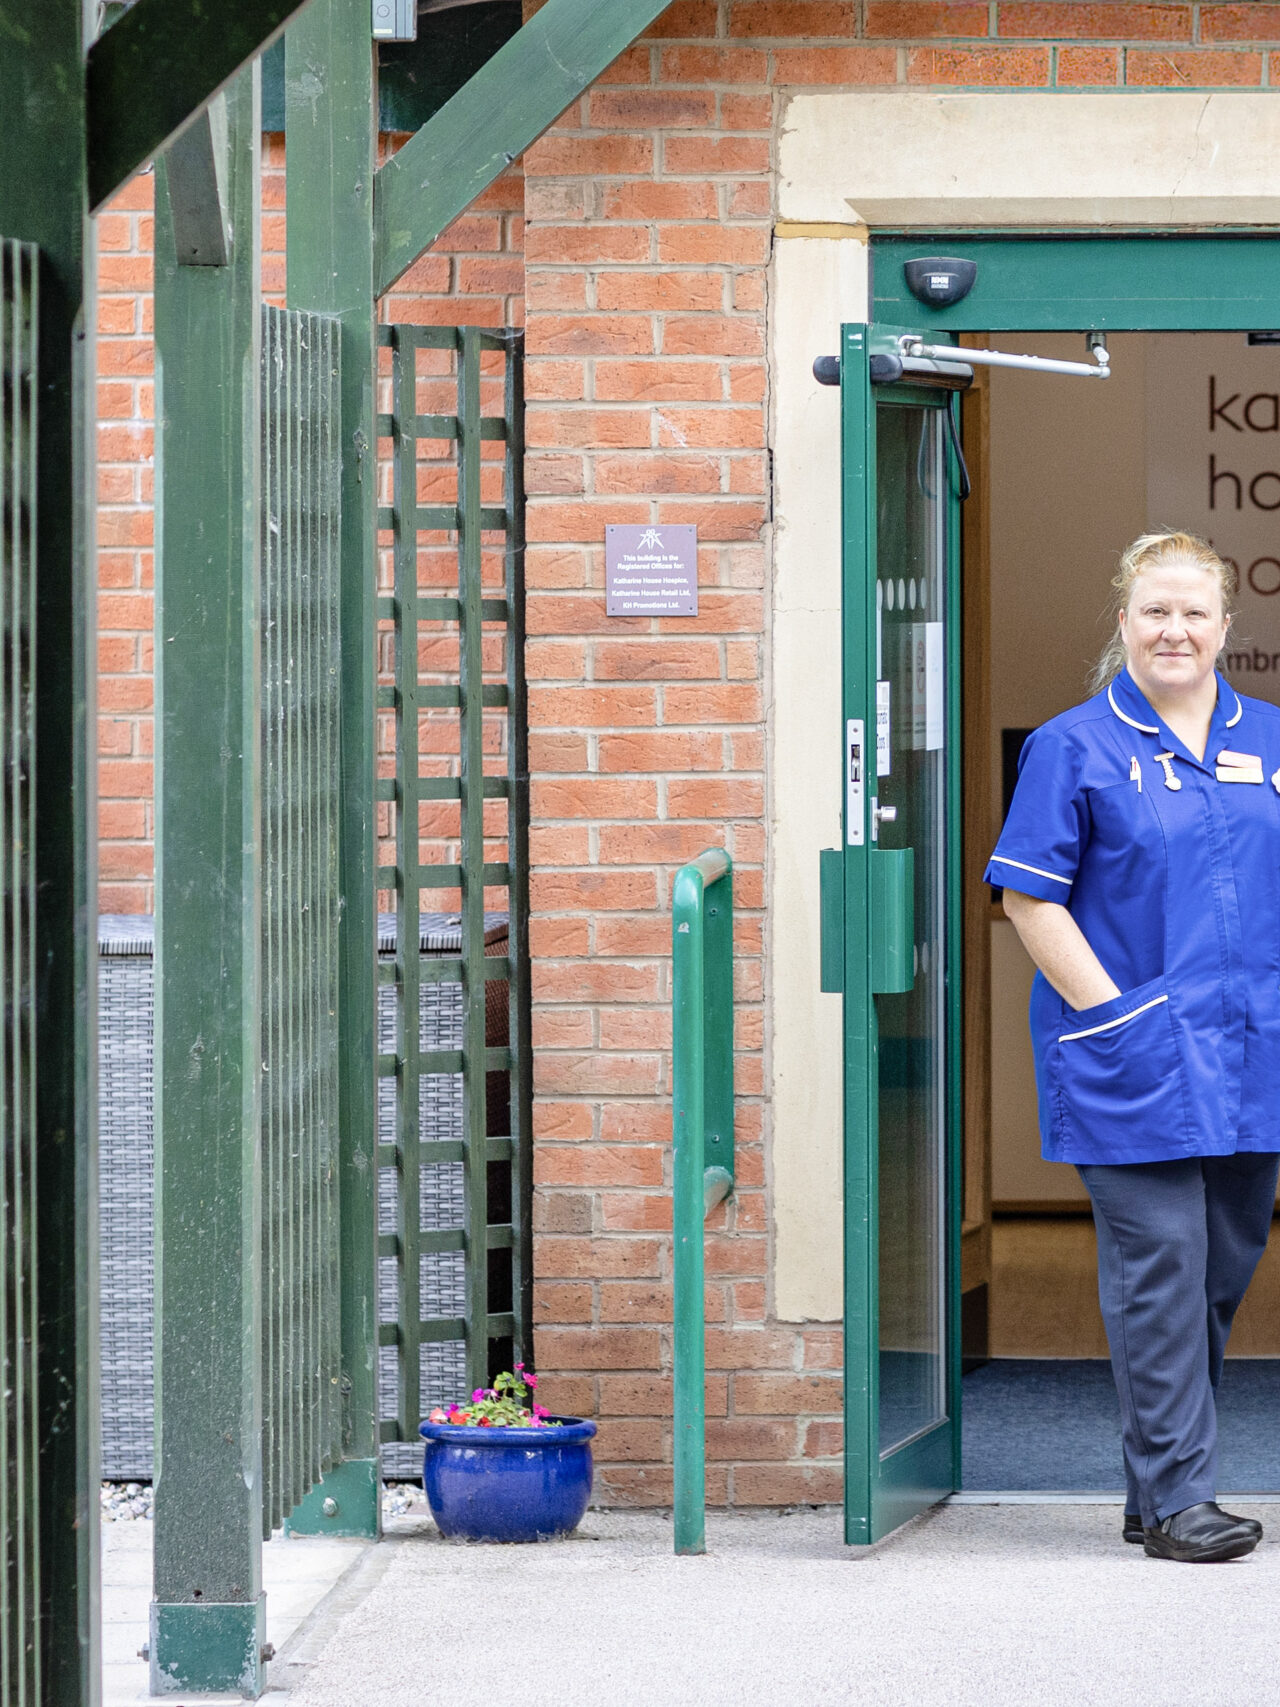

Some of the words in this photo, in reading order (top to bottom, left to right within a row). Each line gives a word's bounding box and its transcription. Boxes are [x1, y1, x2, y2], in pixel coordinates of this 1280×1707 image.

[617, 562, 650, 571] Registered
[641, 589, 660, 597] House
[661, 589, 679, 597] Retail
